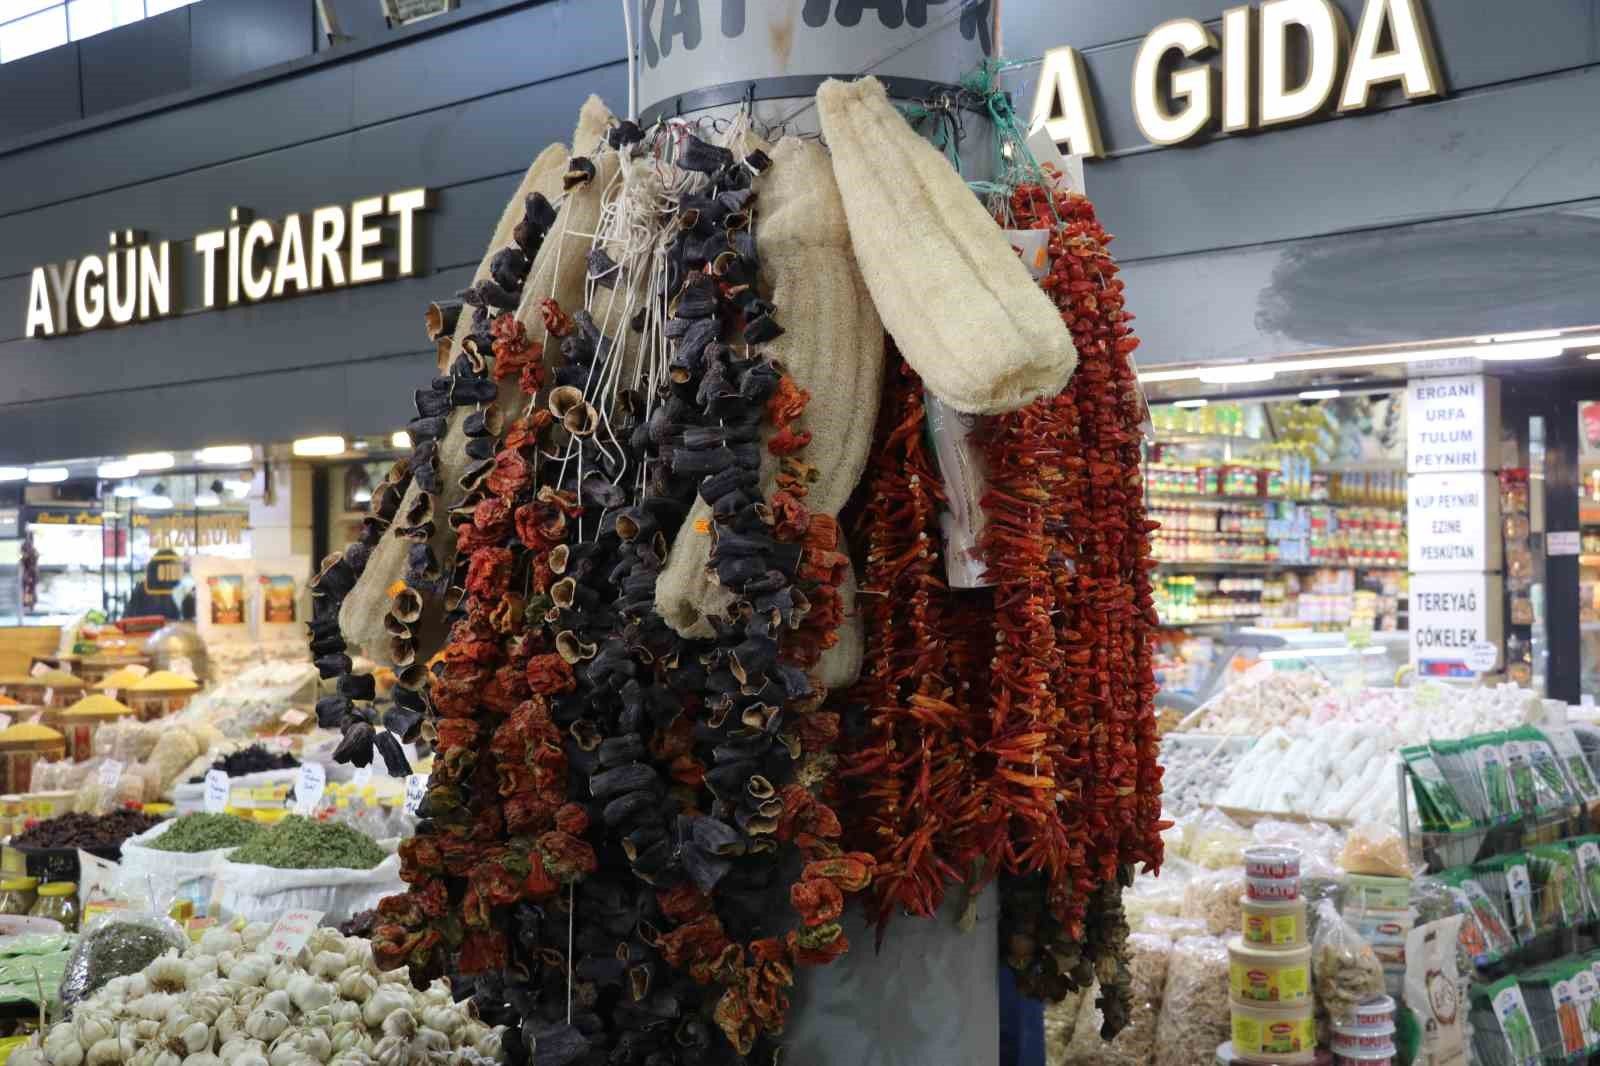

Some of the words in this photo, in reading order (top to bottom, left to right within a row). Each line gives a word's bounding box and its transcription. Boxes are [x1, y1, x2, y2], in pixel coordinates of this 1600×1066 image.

[1131, 0, 1443, 147] GIDA
[26, 229, 171, 339] AYGÜN
[195, 186, 428, 308] TİCARET
[1416, 384, 1476, 401] ERGANİ
[1425, 408, 1466, 422] URFA
[1419, 429, 1474, 444] TULUM
[1415, 449, 1478, 466] PEYNİRİ
[1416, 590, 1477, 612] TEREYAĞ
[1416, 625, 1478, 653] ÇÖKELEK
